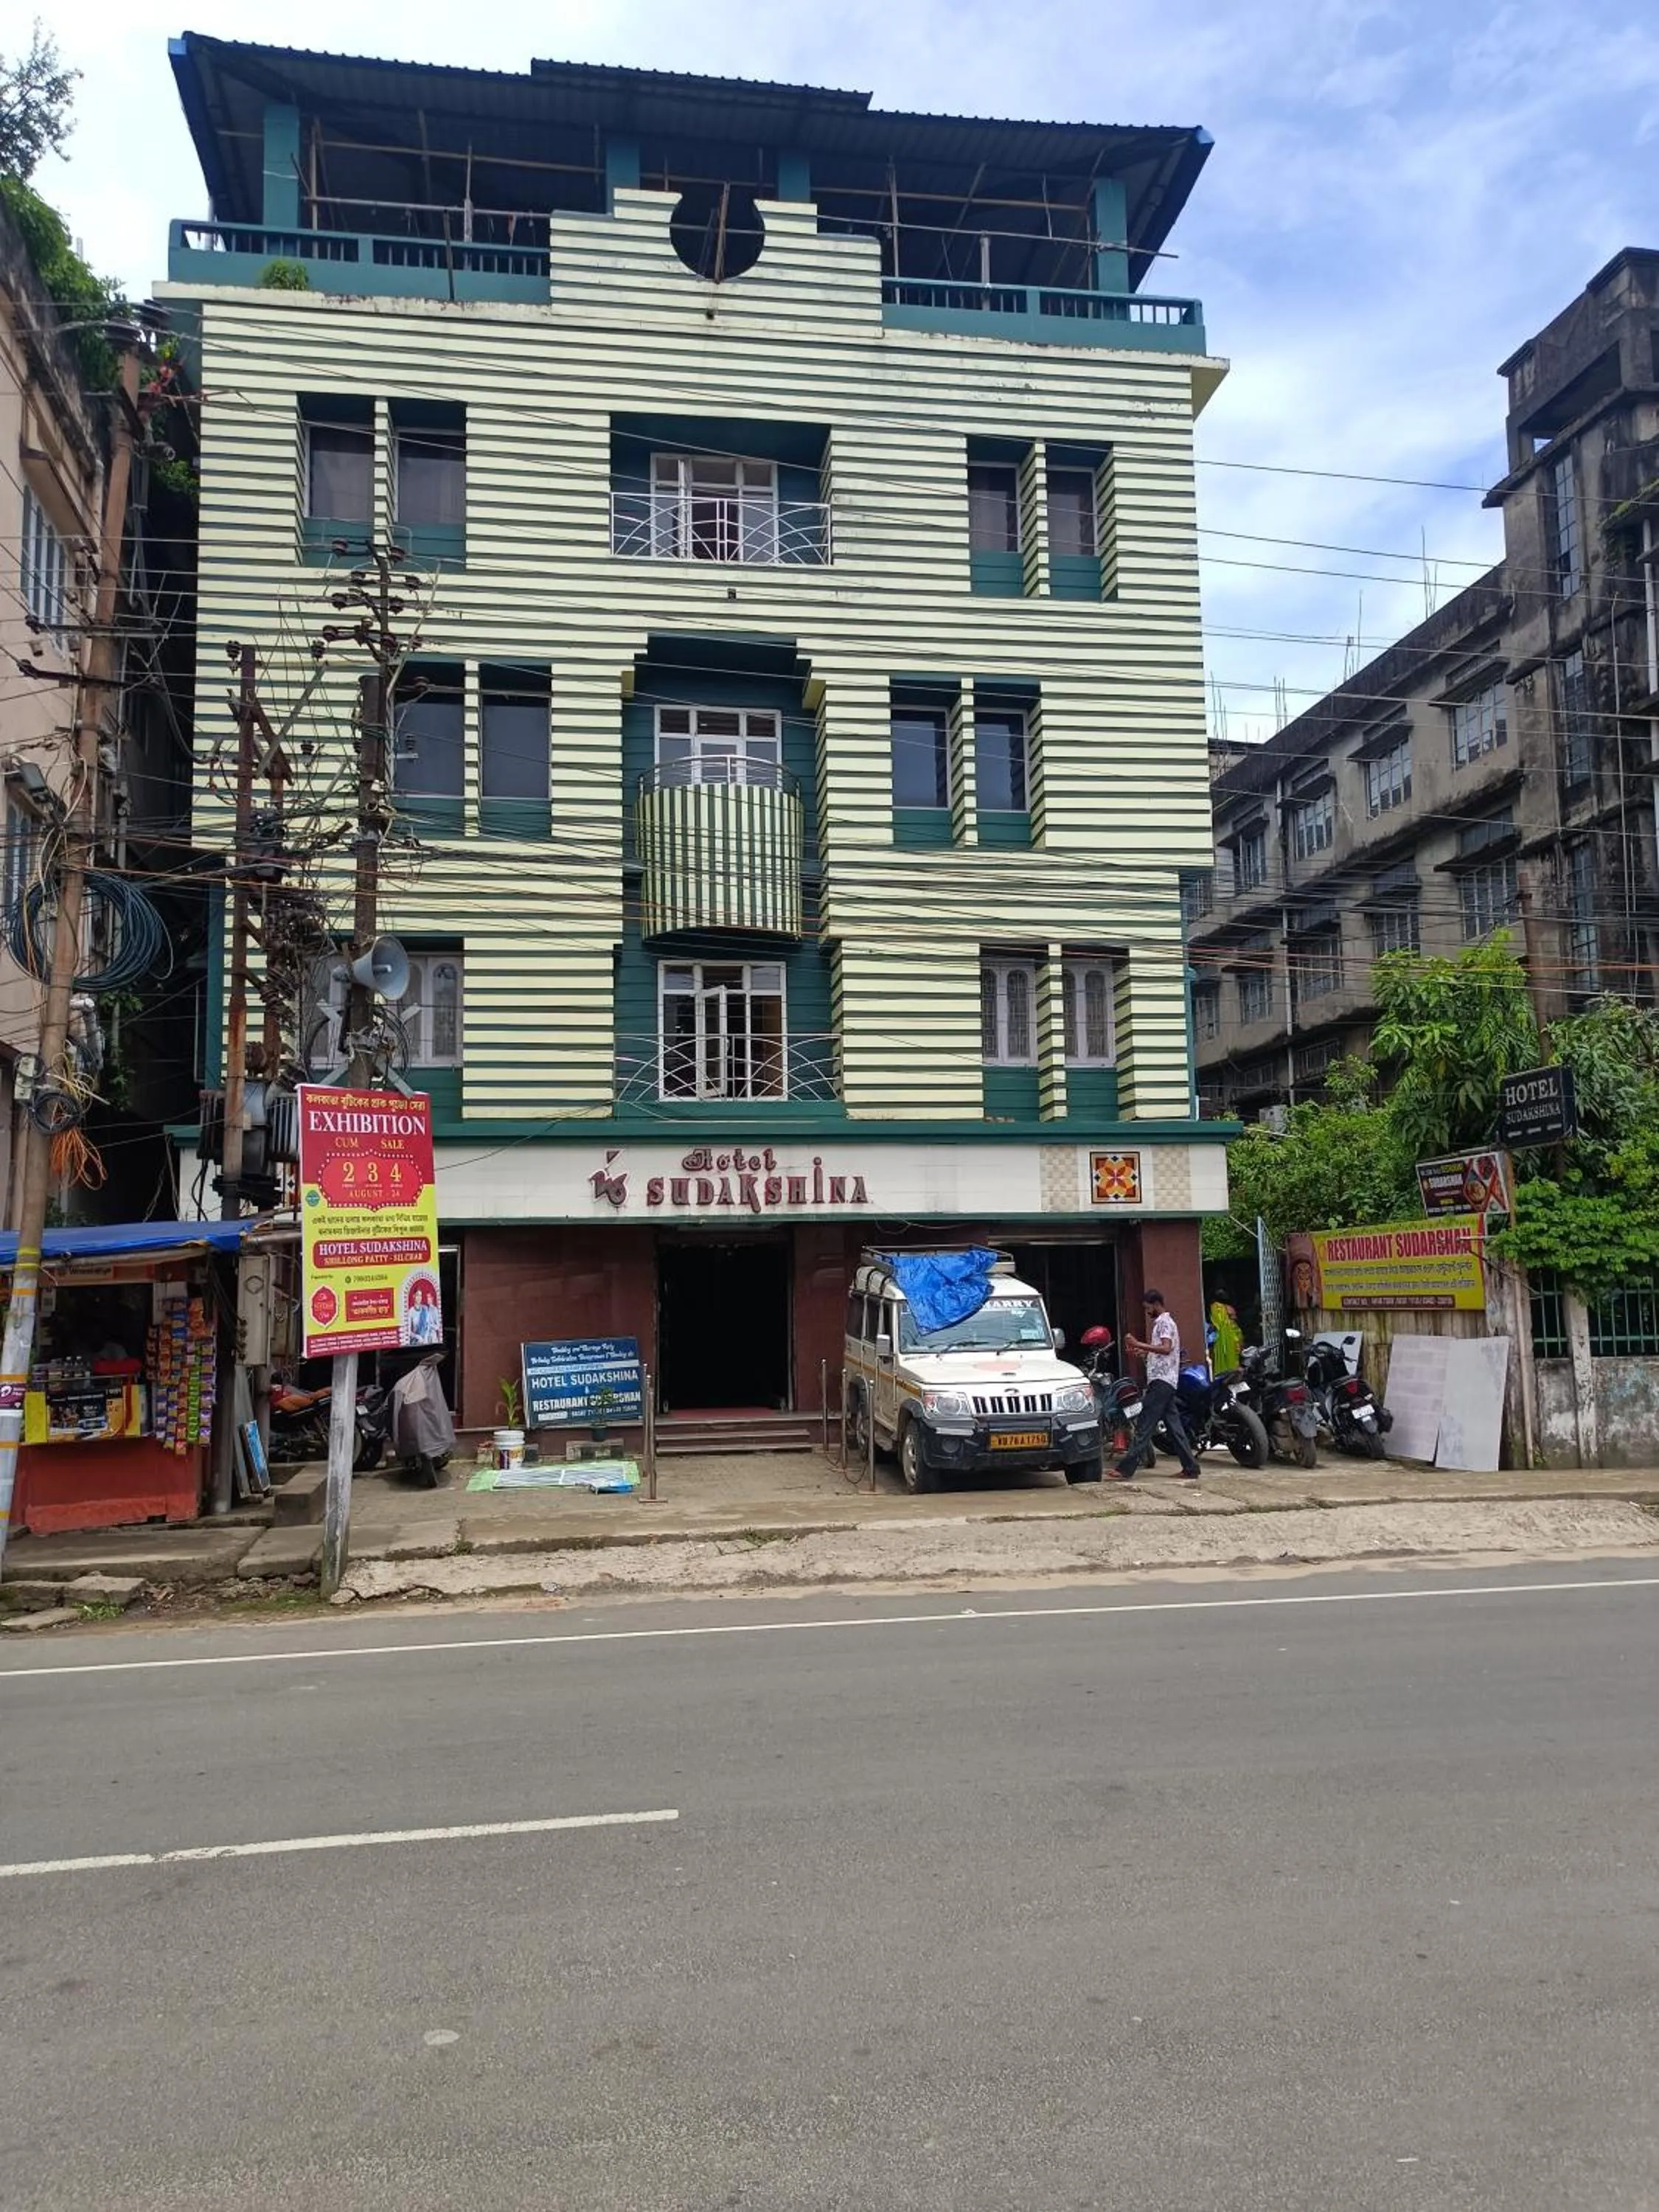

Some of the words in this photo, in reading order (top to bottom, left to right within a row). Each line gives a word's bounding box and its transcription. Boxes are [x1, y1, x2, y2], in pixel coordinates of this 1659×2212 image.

[1505, 1077, 1558, 1106] HOTEL
[308, 1110, 425, 1135] EXHIBITION
[1505, 1102, 1561, 1124] SUDAKSHINA
[335, 1137, 358, 1149] CUM
[380, 1138, 405, 1150] SALE
[682, 1148, 777, 1172] Hotel
[342, 1161, 355, 1183] 2
[367, 1161, 378, 1183] 3
[390, 1162, 402, 1183] 4
[349, 1189, 383, 1198] AUGUST
[319, 1242, 358, 1256] HOTEL
[360, 1239, 428, 1254] SUDAKSHINA
[1328, 1234, 1393, 1262] RESTAURANT
[1396, 1227, 1472, 1256] SUDARSHAN
[532, 1375, 568, 1388] HOTEL
[571, 1369, 639, 1385] SUDAKSHINA
[533, 1395, 588, 1411] RESTAURANT
[590, 1391, 641, 1405] SURSHAN
